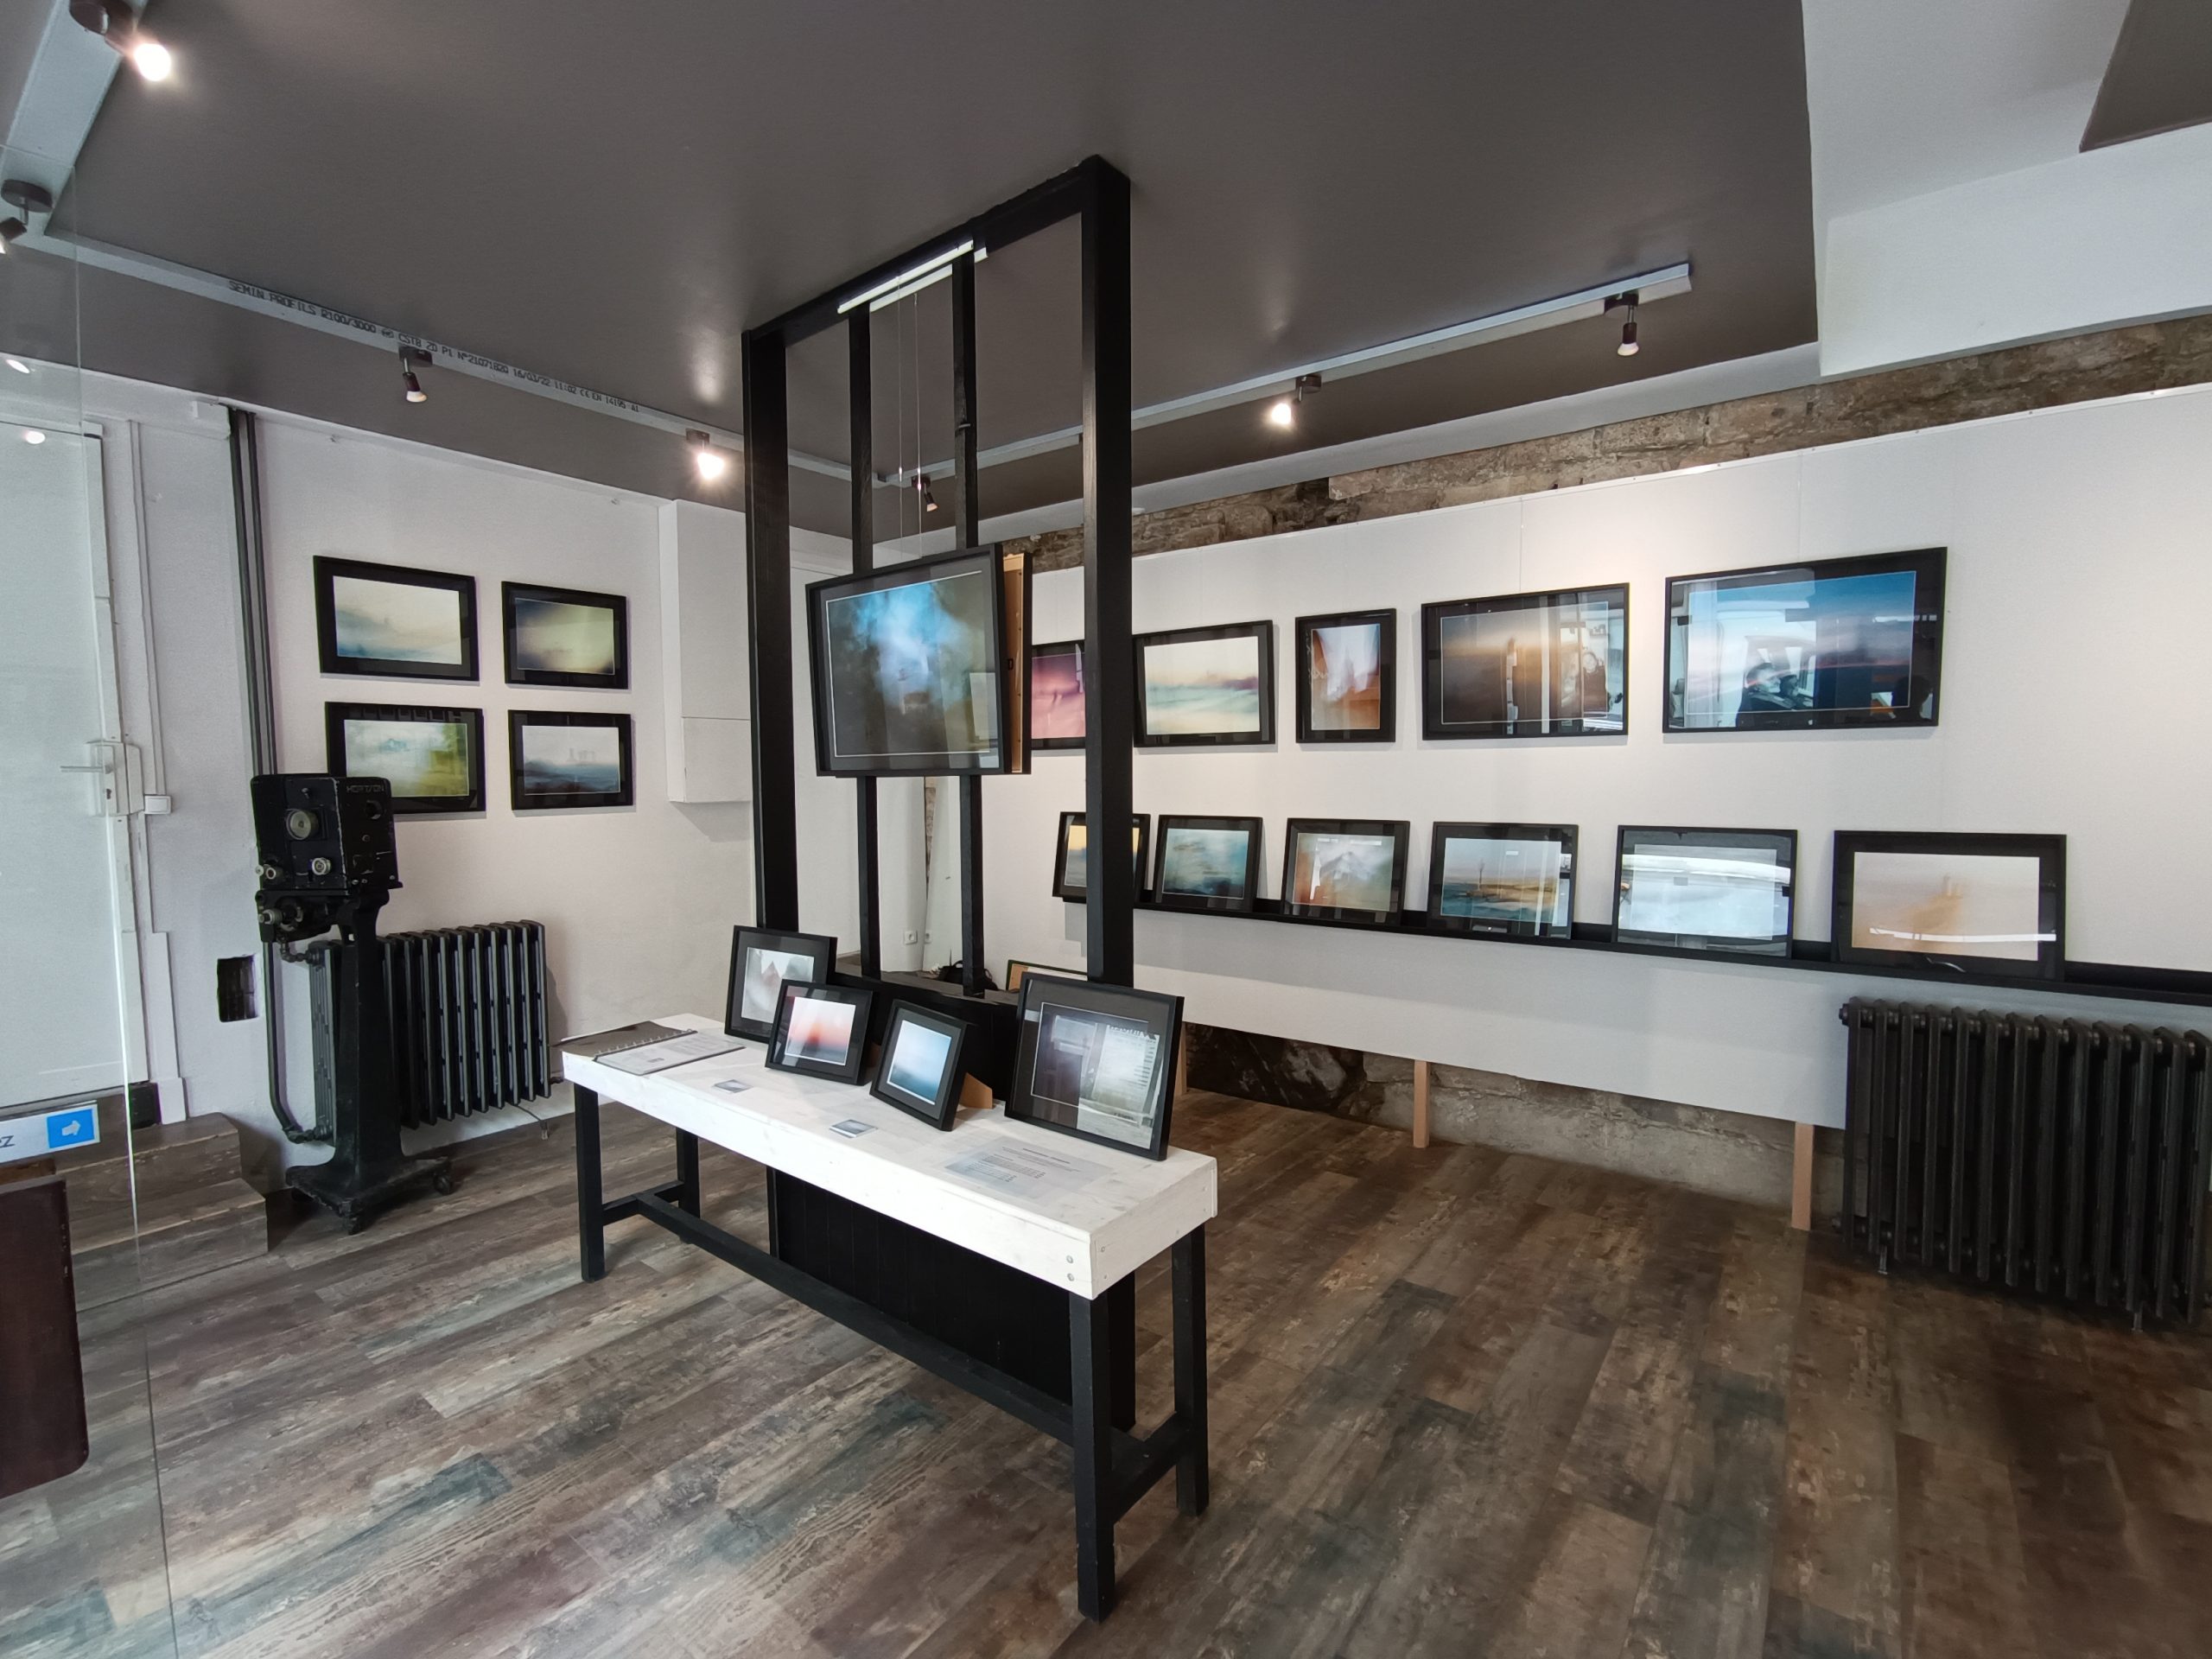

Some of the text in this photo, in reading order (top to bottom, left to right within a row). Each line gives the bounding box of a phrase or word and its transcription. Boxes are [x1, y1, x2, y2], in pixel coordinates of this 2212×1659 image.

[229, 281, 265, 300] SEMIN
[270, 293, 316, 316] PROFILS
[321, 309, 377, 334] R100/3000
[398, 333, 422, 347] CSTB
[0, 1135, 16, 1148] z
